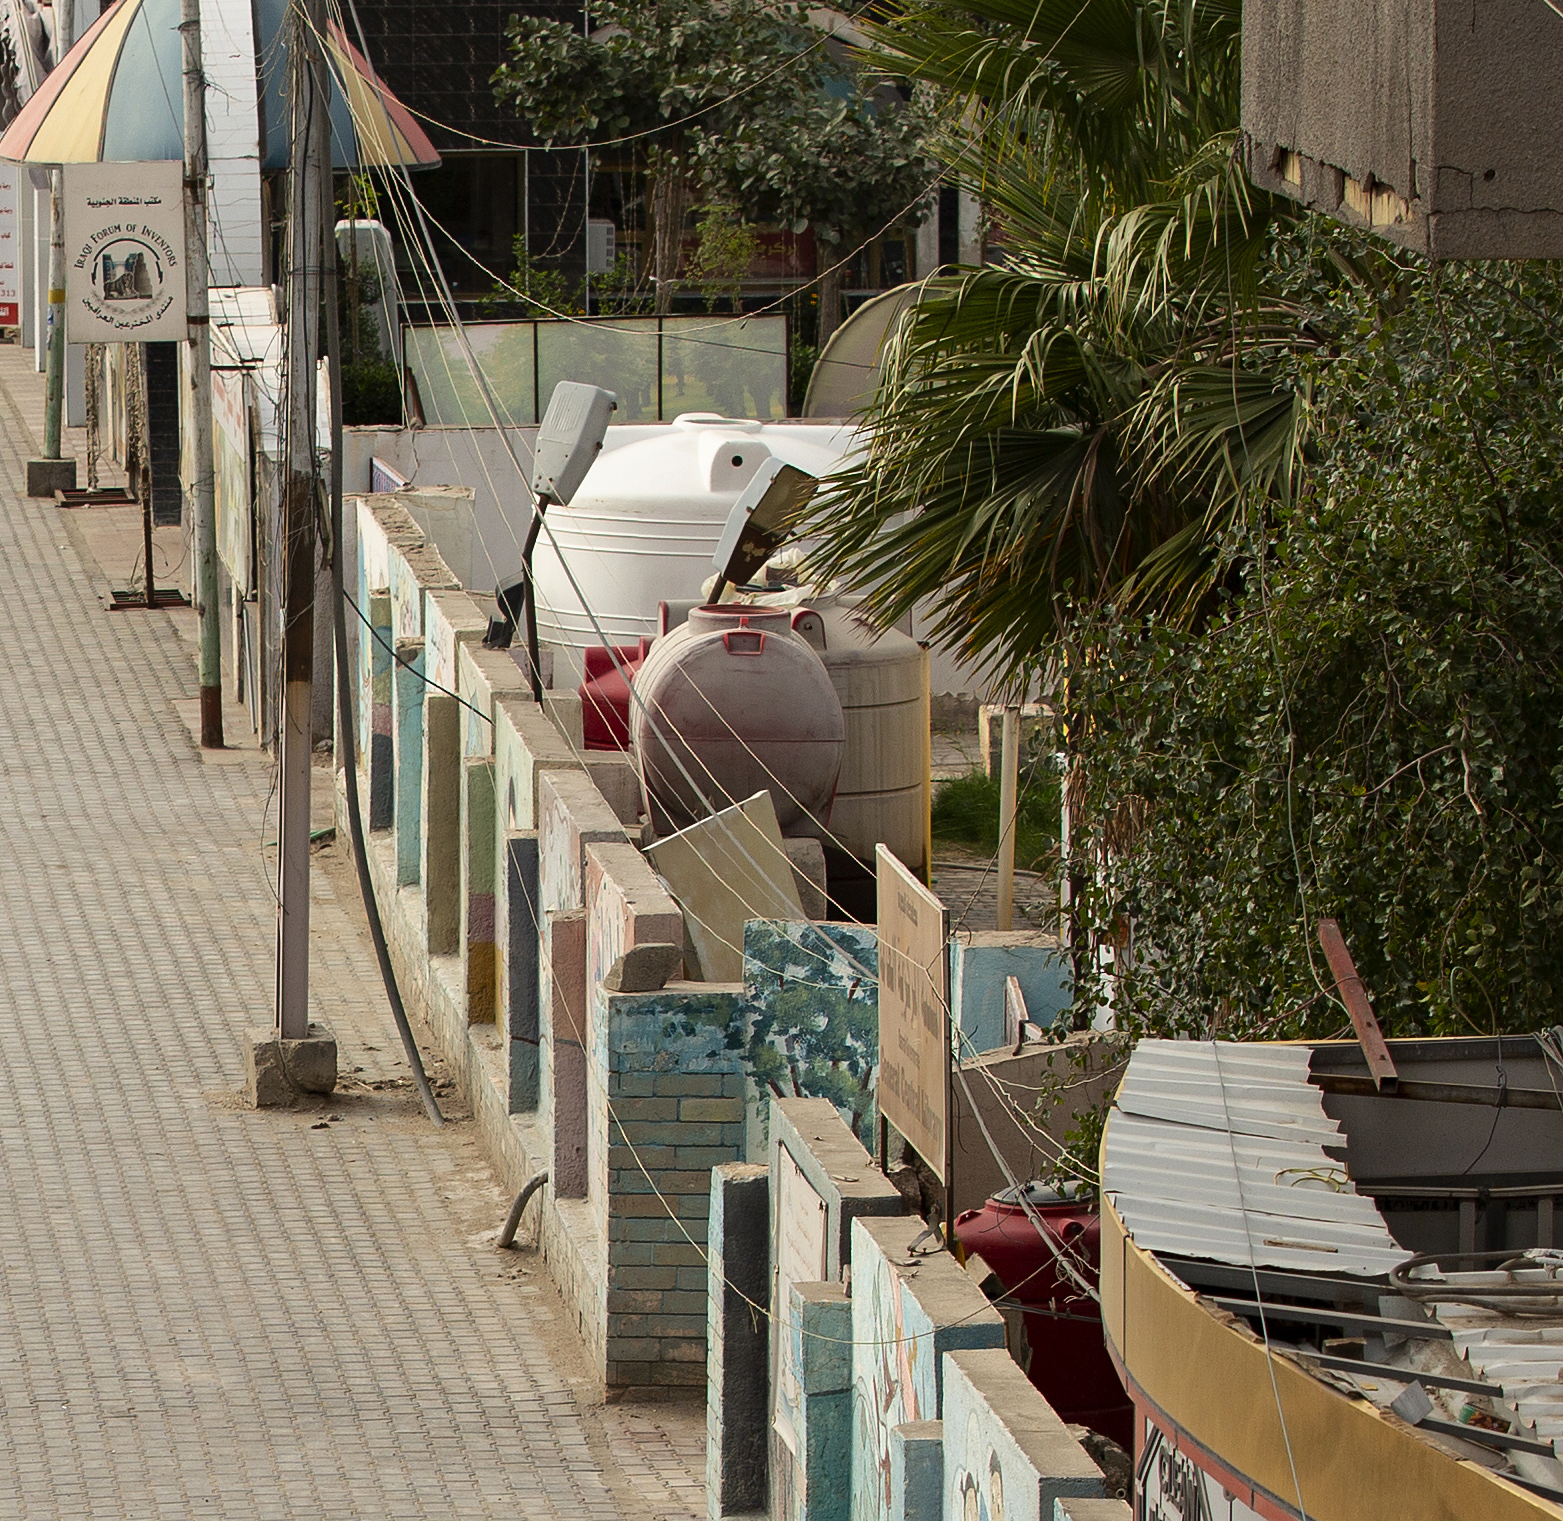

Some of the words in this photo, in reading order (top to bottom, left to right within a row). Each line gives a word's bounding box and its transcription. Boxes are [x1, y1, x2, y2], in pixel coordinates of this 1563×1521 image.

[86, 197, 117, 209] الجنوبية
[118, 196, 142, 206] المنطقة
[143, 196, 162, 207] مكتب
[74, 243, 93, 269] IRAQI
[90, 223, 122, 244] FORUM
[125, 223, 137, 233] OF
[141, 225, 178, 267] INVENTORS
[81, 298, 114, 324] العراقيين
[155, 296, 174, 320] منتدى
[114, 314, 154, 330] المخترعين
